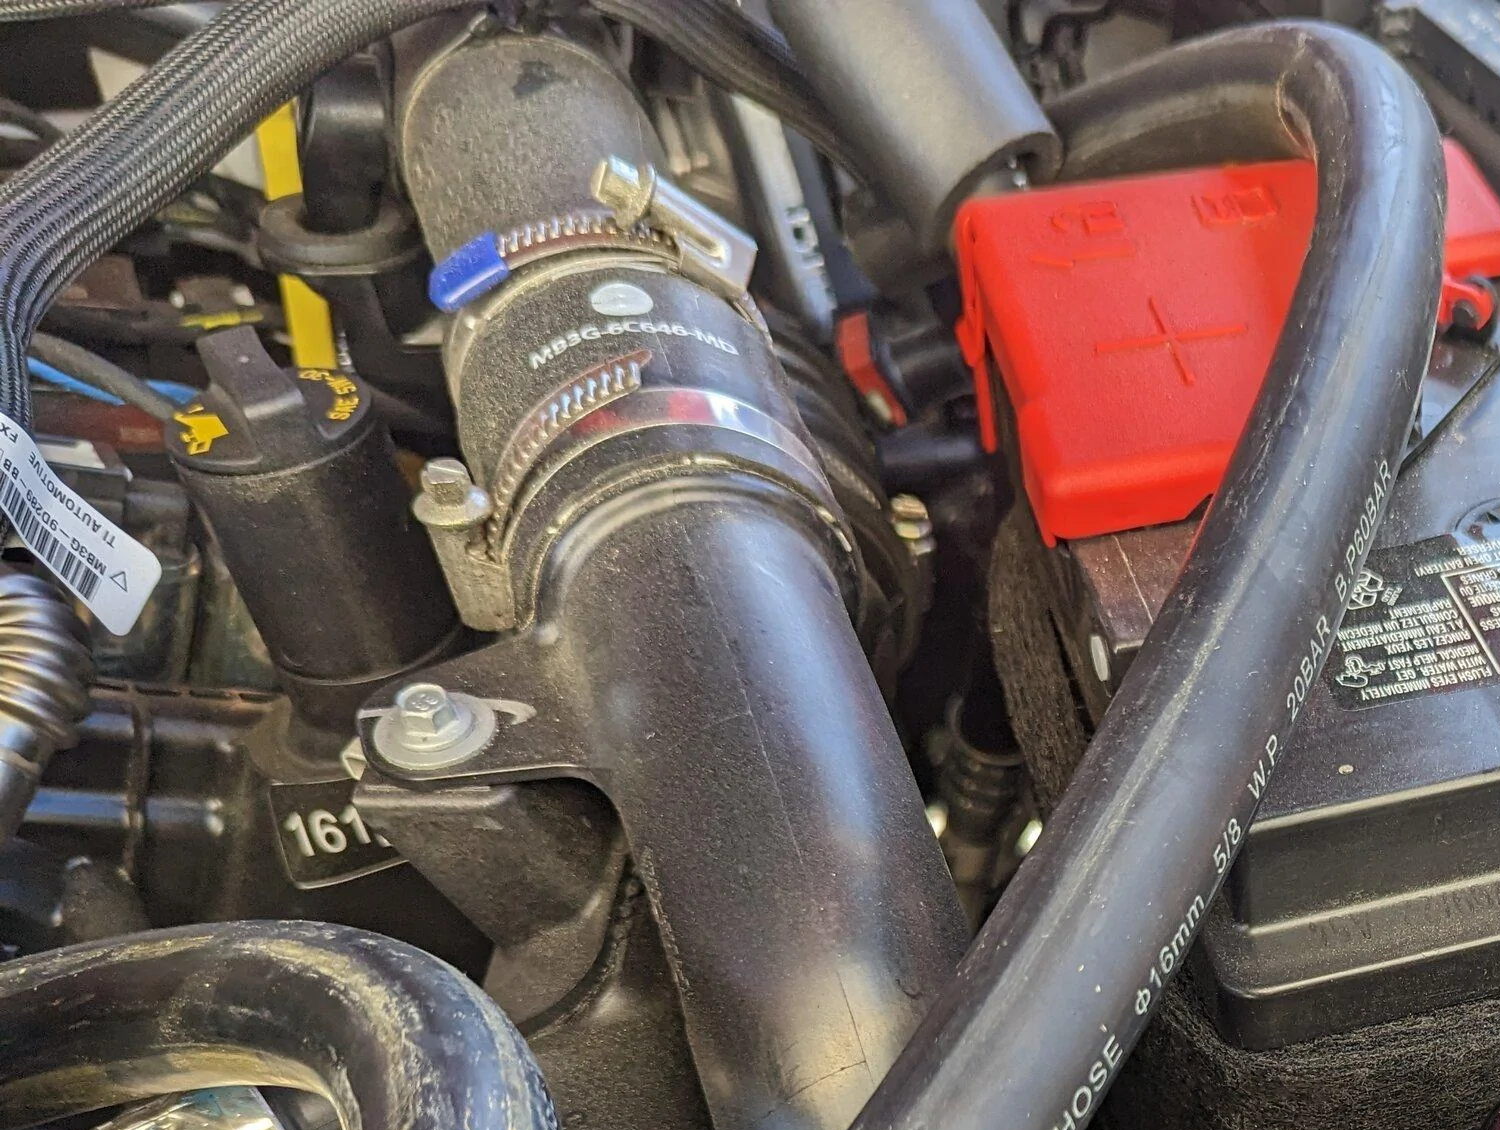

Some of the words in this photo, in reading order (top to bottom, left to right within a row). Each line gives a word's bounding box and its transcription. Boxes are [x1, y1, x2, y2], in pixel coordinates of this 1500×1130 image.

[327, 397, 360, 421] SAE
[28, 451, 103, 534] AUTOMOTIVE
[101, 533, 117, 549] TI
[1464, 552, 1492, 566] OPEN
[1414, 559, 1462, 576] BATTERY!
[1460, 569, 1497, 584] GRAVES
[1459, 586, 1473, 596] OU
[1383, 620, 1400, 631] UN
[1400, 609, 1458, 628] CONSULTEZ
[1413, 637, 1433, 649] LES
[1433, 630, 1470, 645] RINCEZ
[1384, 641, 1413, 655] YEUX
[1437, 644, 1479, 659] MEDICAL
[1413, 652, 1437, 665] HELP
[1457, 655, 1486, 669] WITH
[1396, 669, 1416, 681] GET
[1430, 673, 1457, 687] EYES
[1457, 666, 1492, 681] FLUSH
[1361, 679, 1430, 700] IMMEDIATELY
[1212, 816, 1244, 875] 5/8
[1286, 614, 1331, 722] 20BAR
